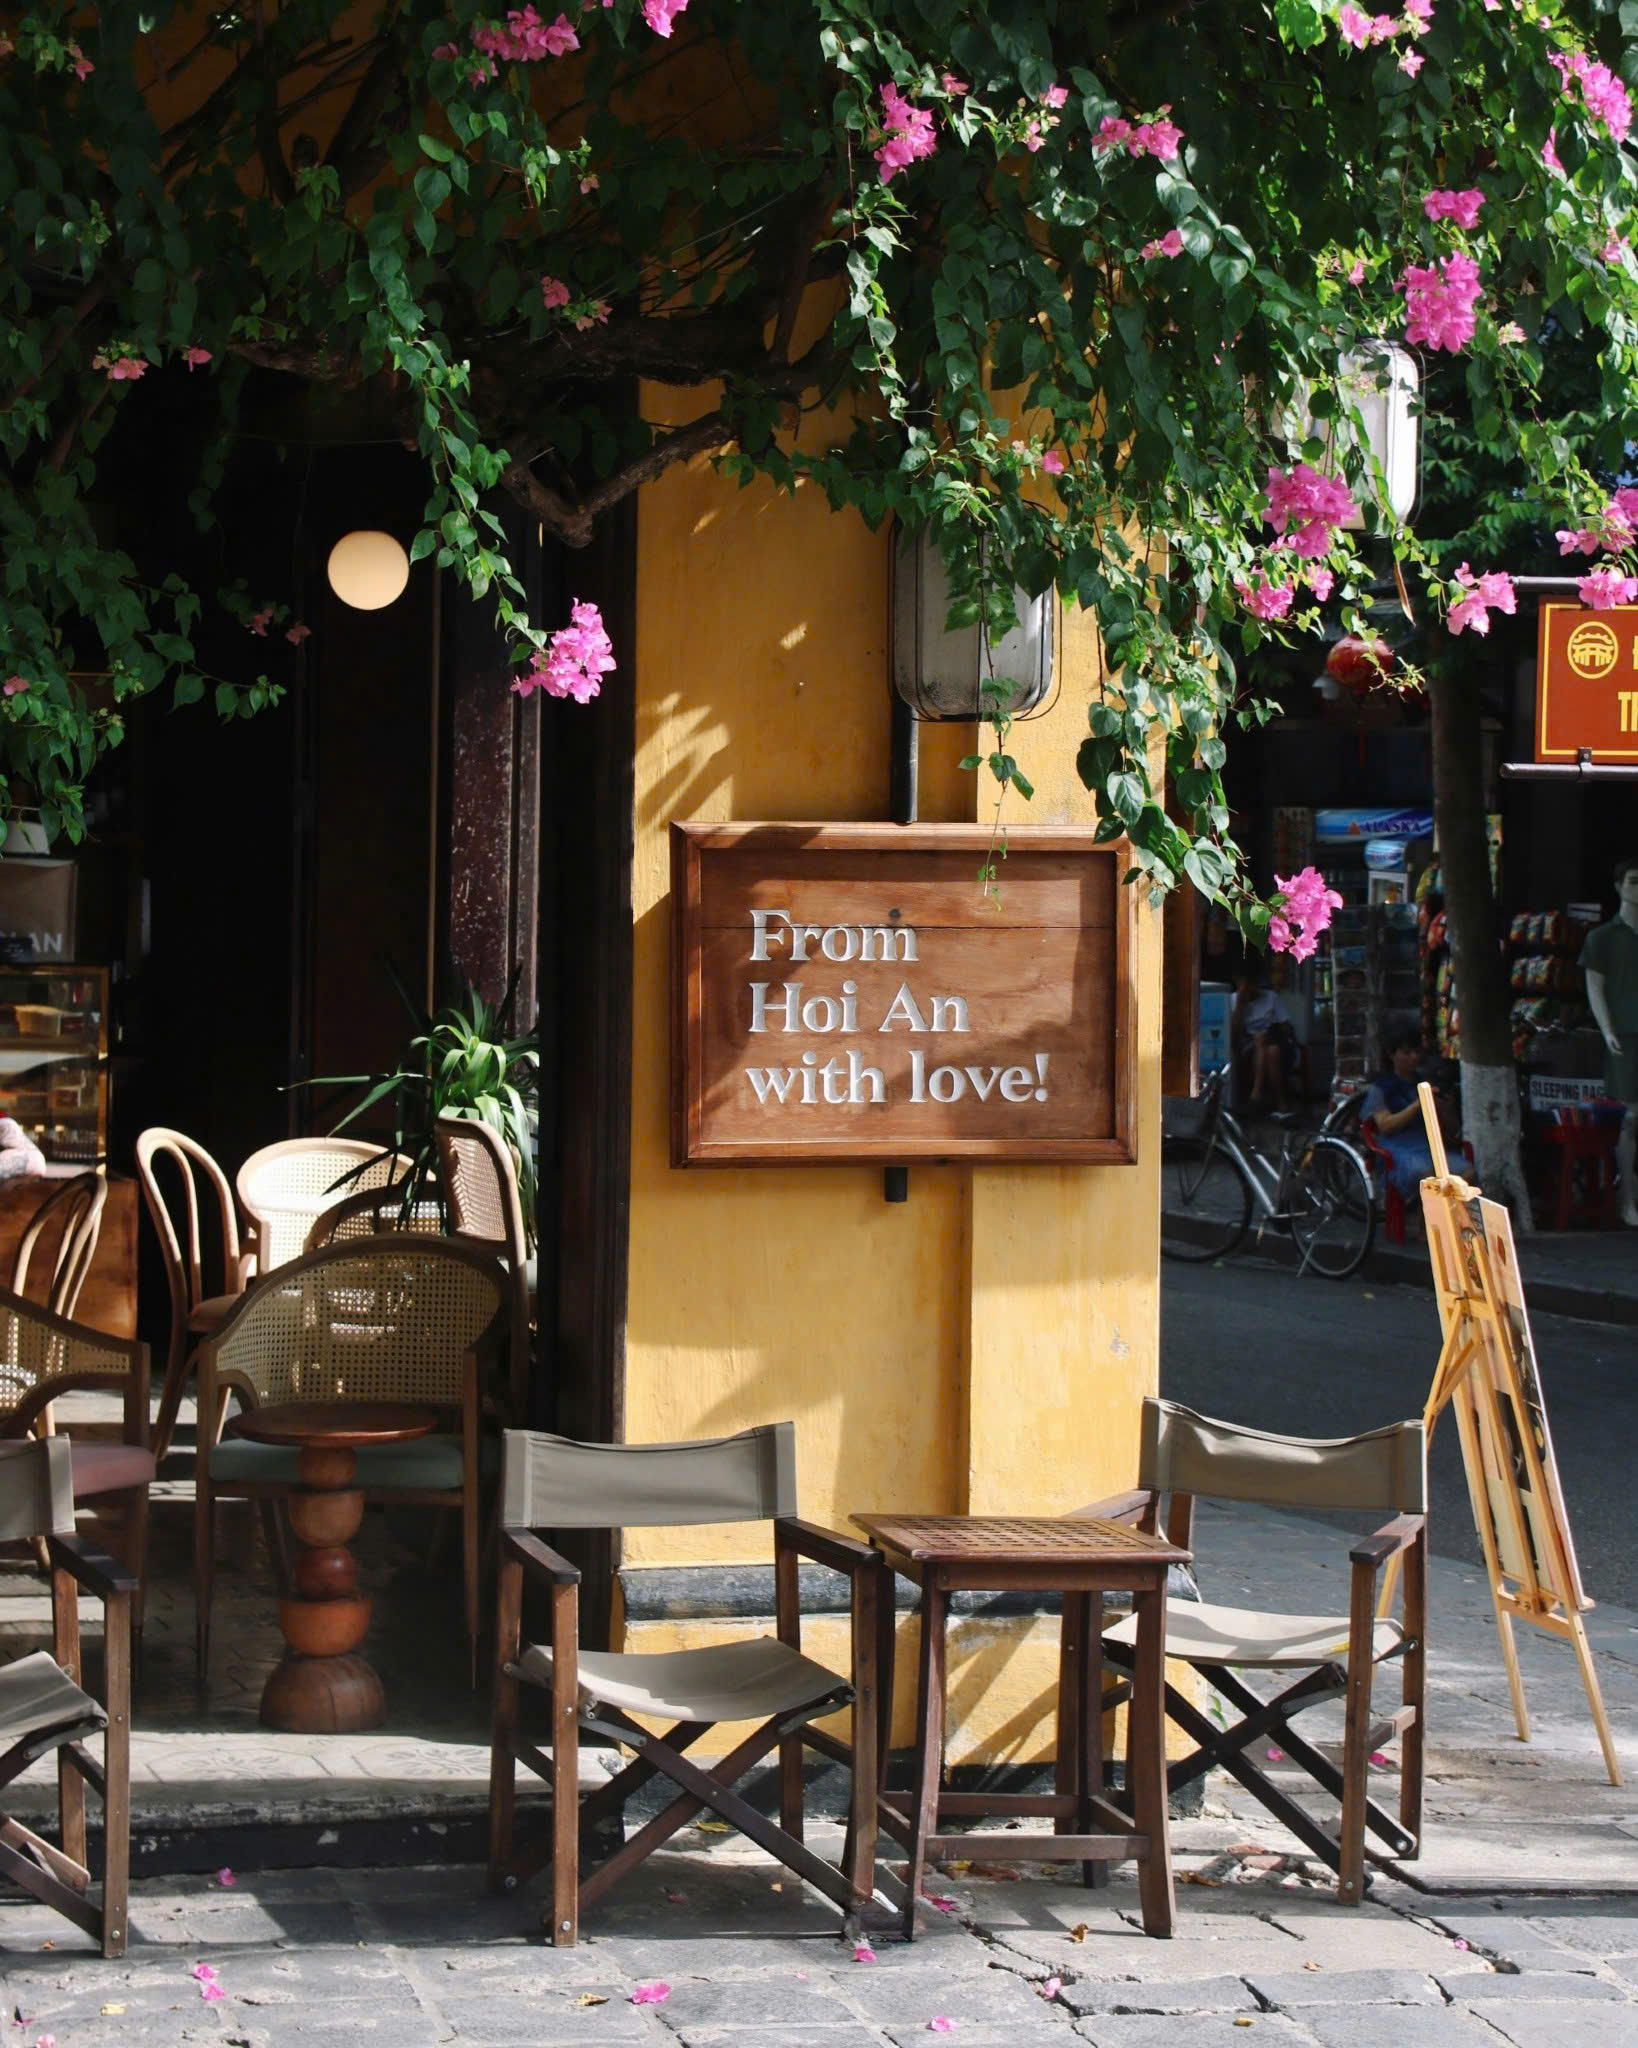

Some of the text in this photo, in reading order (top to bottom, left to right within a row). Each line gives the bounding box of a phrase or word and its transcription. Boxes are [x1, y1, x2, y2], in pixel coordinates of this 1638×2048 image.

[1361, 820, 1422, 833] ALASKA
[749, 909, 920, 962] From
[748, 980, 971, 1033] Hoi An
[745, 1049, 1050, 1105] with love!
[1531, 1081, 1580, 1100] SLEEPING
